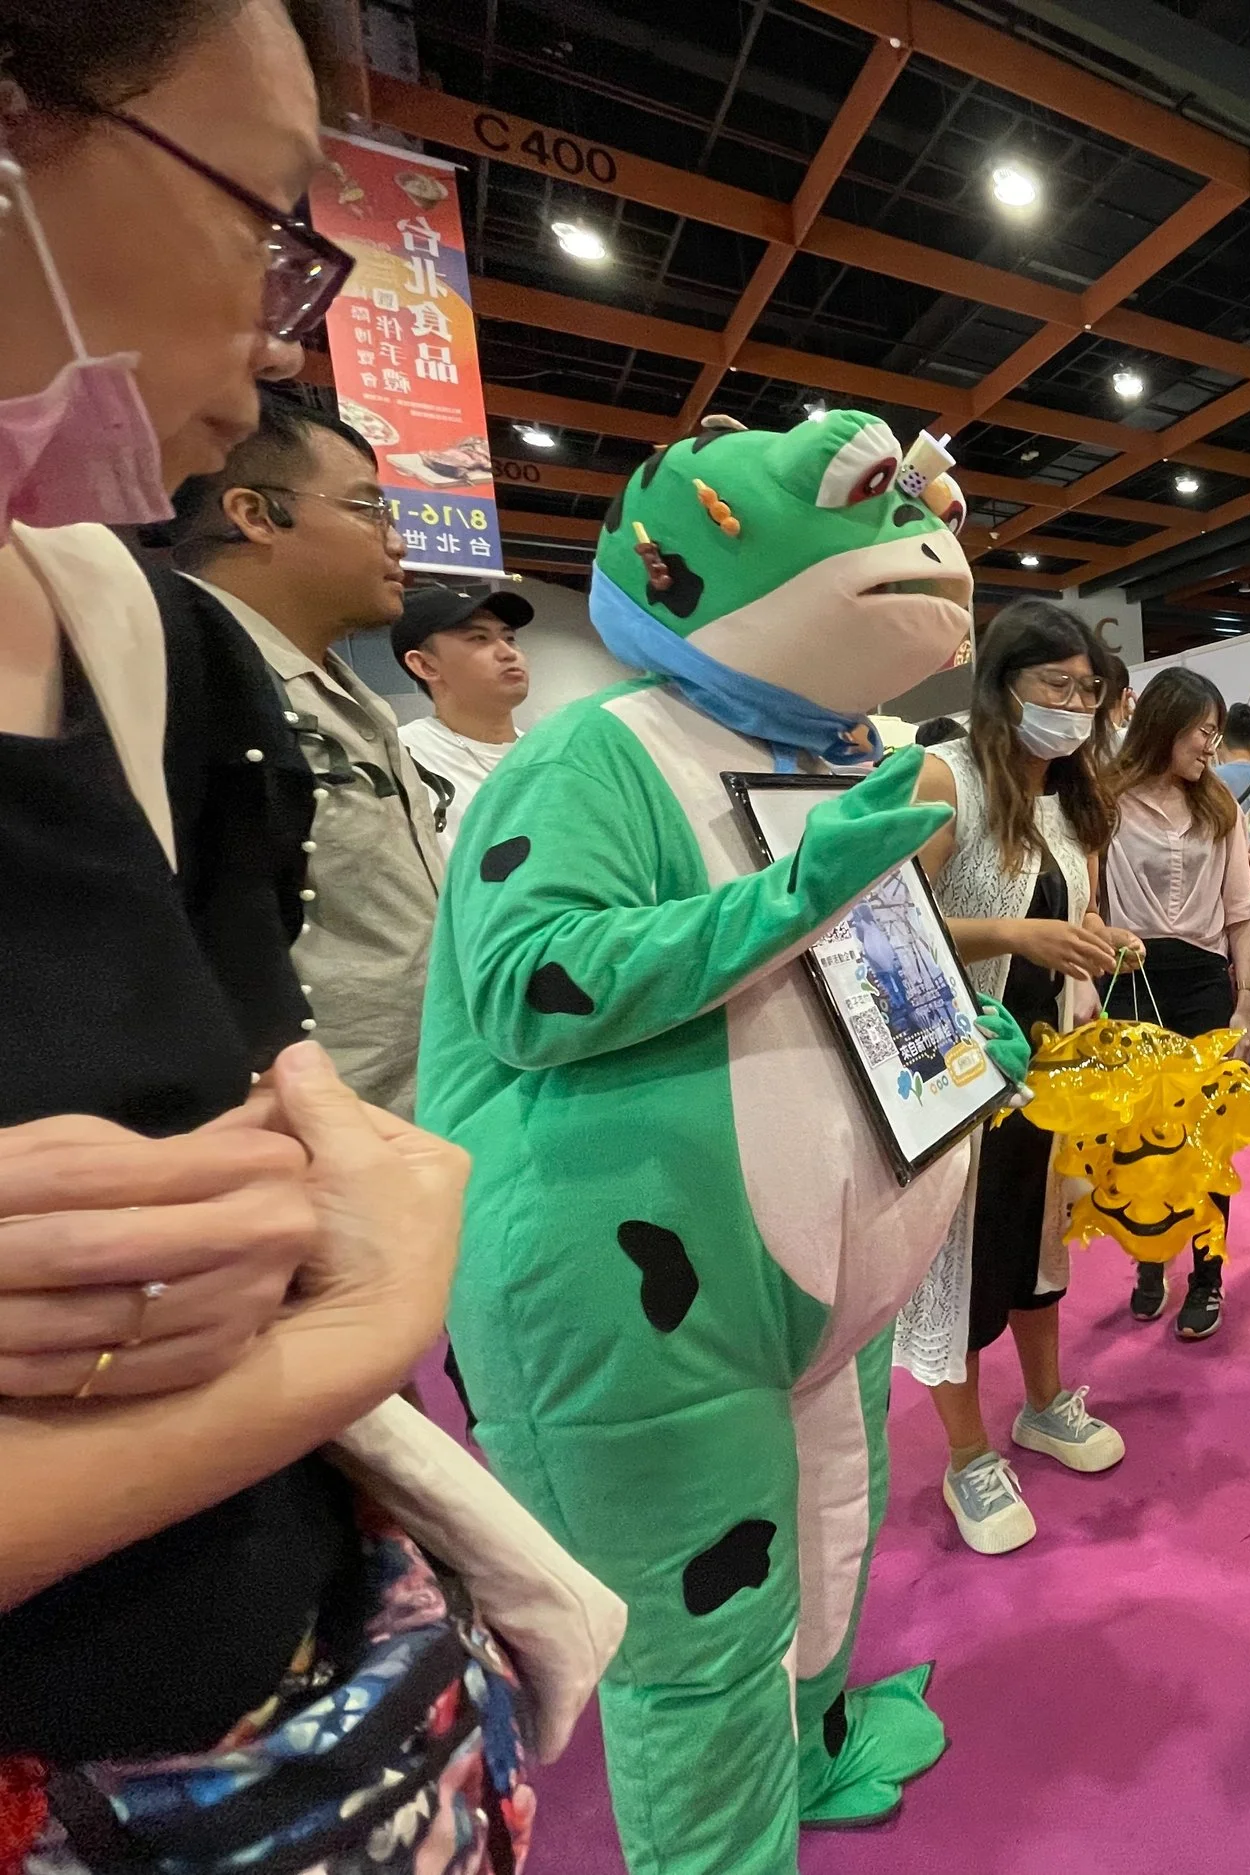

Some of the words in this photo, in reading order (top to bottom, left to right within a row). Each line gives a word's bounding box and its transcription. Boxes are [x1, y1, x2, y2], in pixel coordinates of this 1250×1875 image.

[474, 114, 510, 152] C
[520, 130, 617, 184] 400
[1096, 617, 1122, 653] C
